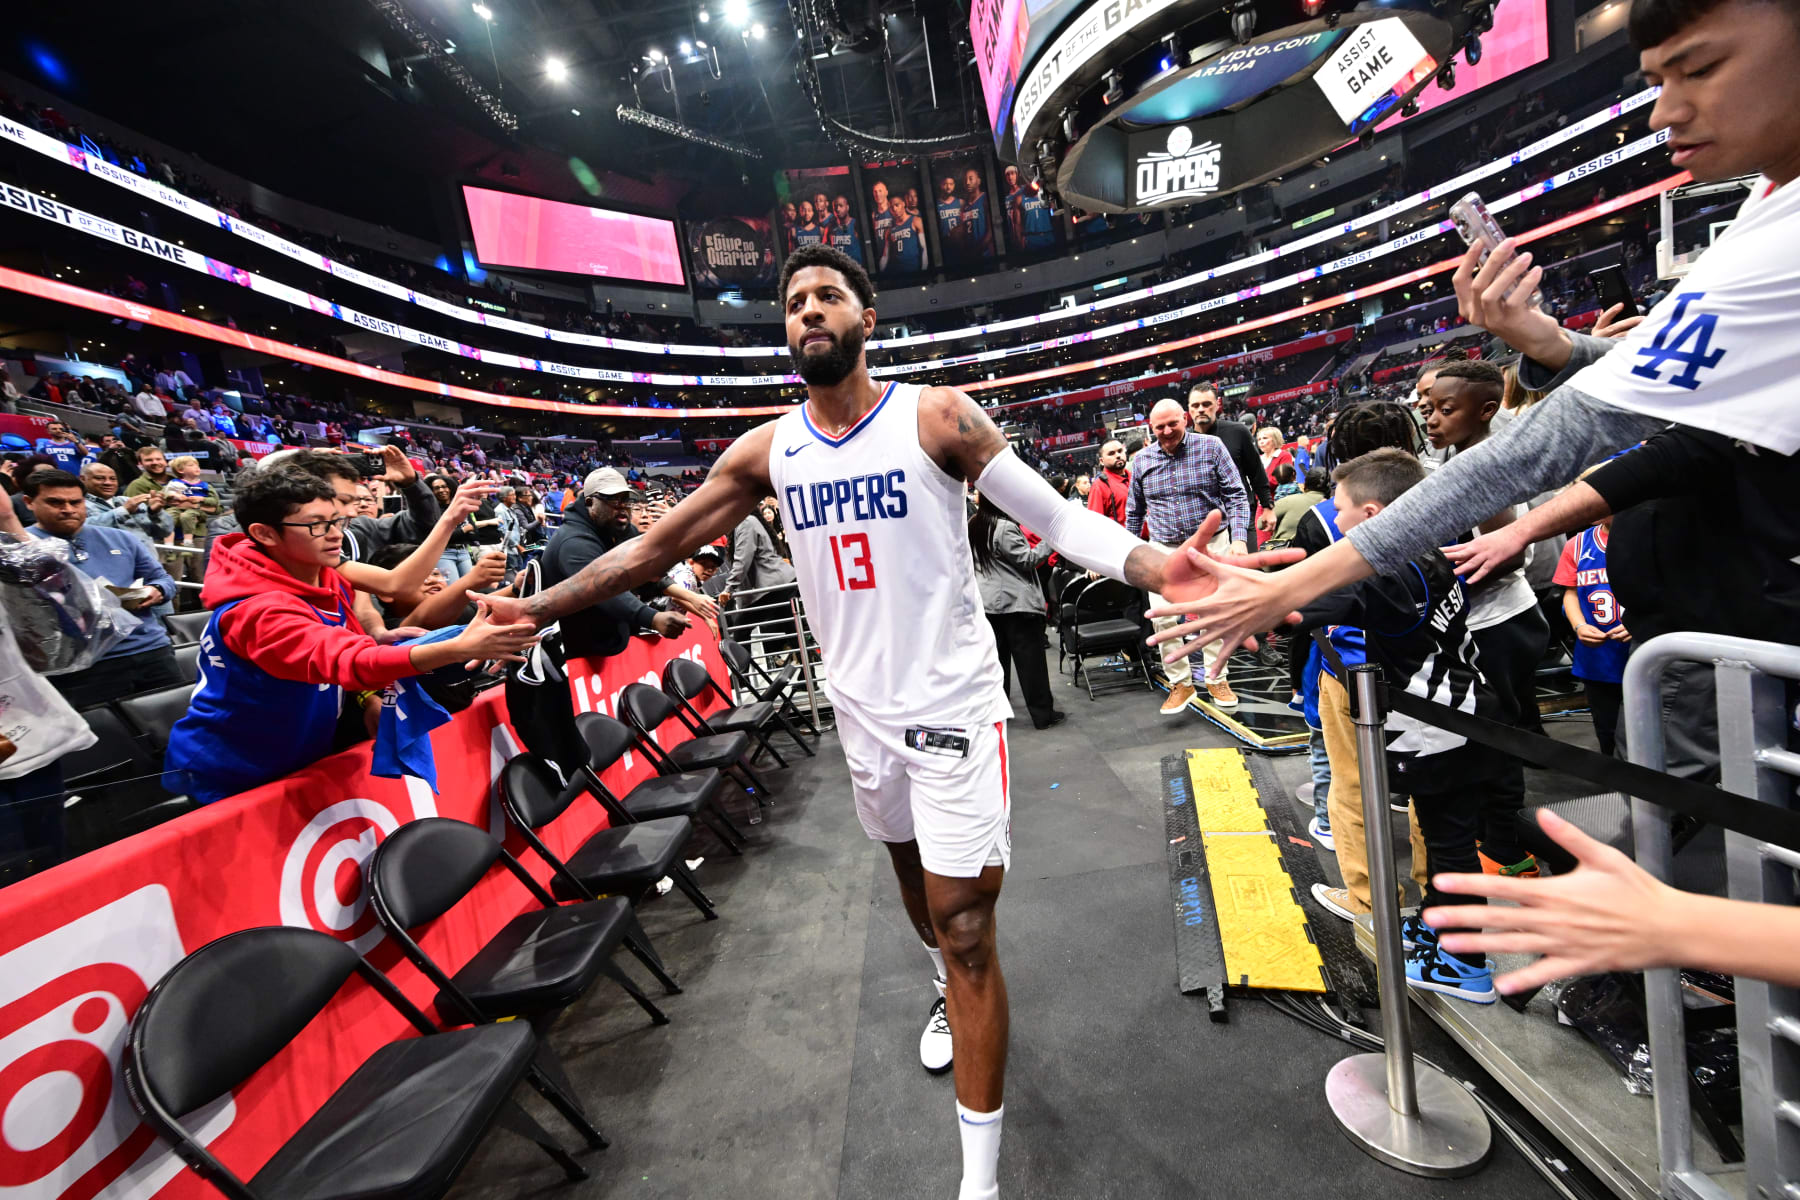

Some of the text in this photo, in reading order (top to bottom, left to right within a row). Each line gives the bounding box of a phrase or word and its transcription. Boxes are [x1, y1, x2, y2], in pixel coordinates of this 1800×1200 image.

[1338, 28, 1376, 74] ASSIST
[1019, 49, 1063, 122] ASSIST
[1065, 43, 1077, 58] OF
[1079, 22, 1099, 44] THE
[1187, 59, 1256, 80] ARENA
[1347, 45, 1393, 94] GAME
[1522, 124, 1585, 157] ASSIST GAME
[1136, 150, 1222, 201] CLIPPERS
[1566, 149, 1625, 182] ASSIST
[92, 161, 138, 188] ASSIST
[159, 190, 192, 211] GAME
[78, 217, 93, 227] OF
[97, 223, 119, 237] THE
[121, 229, 188, 265] GAME
[235, 223, 266, 242] ASSIST
[713, 232, 755, 252] Give no
[897, 240, 903, 252] 0
[706, 246, 760, 268] Quarter
[1332, 231, 1427, 270] ASSIST GAME
[1152, 297, 1228, 324] ASSIST GAME
[353, 312, 396, 335] ASSIST
[418, 333, 449, 351] GAME
[1631, 292, 1727, 390] LA
[550, 363, 623, 381] ASSIST GAME
[710, 377, 738, 385] ASSIST
[752, 376, 775, 384] GAME
[1110, 382, 1135, 396] CLIPPERS
[1268, 387, 1313, 401] CLIPPERS.COM
[45, 447, 76, 456] CLIPPERS
[1061, 432, 1085, 444] CLIPPERS
[785, 469, 908, 531] CLIPPERS
[829, 532, 876, 591] 13
[1170, 777, 1187, 807] CRYPTO
[1181, 876, 1203, 926] CRYPTO
